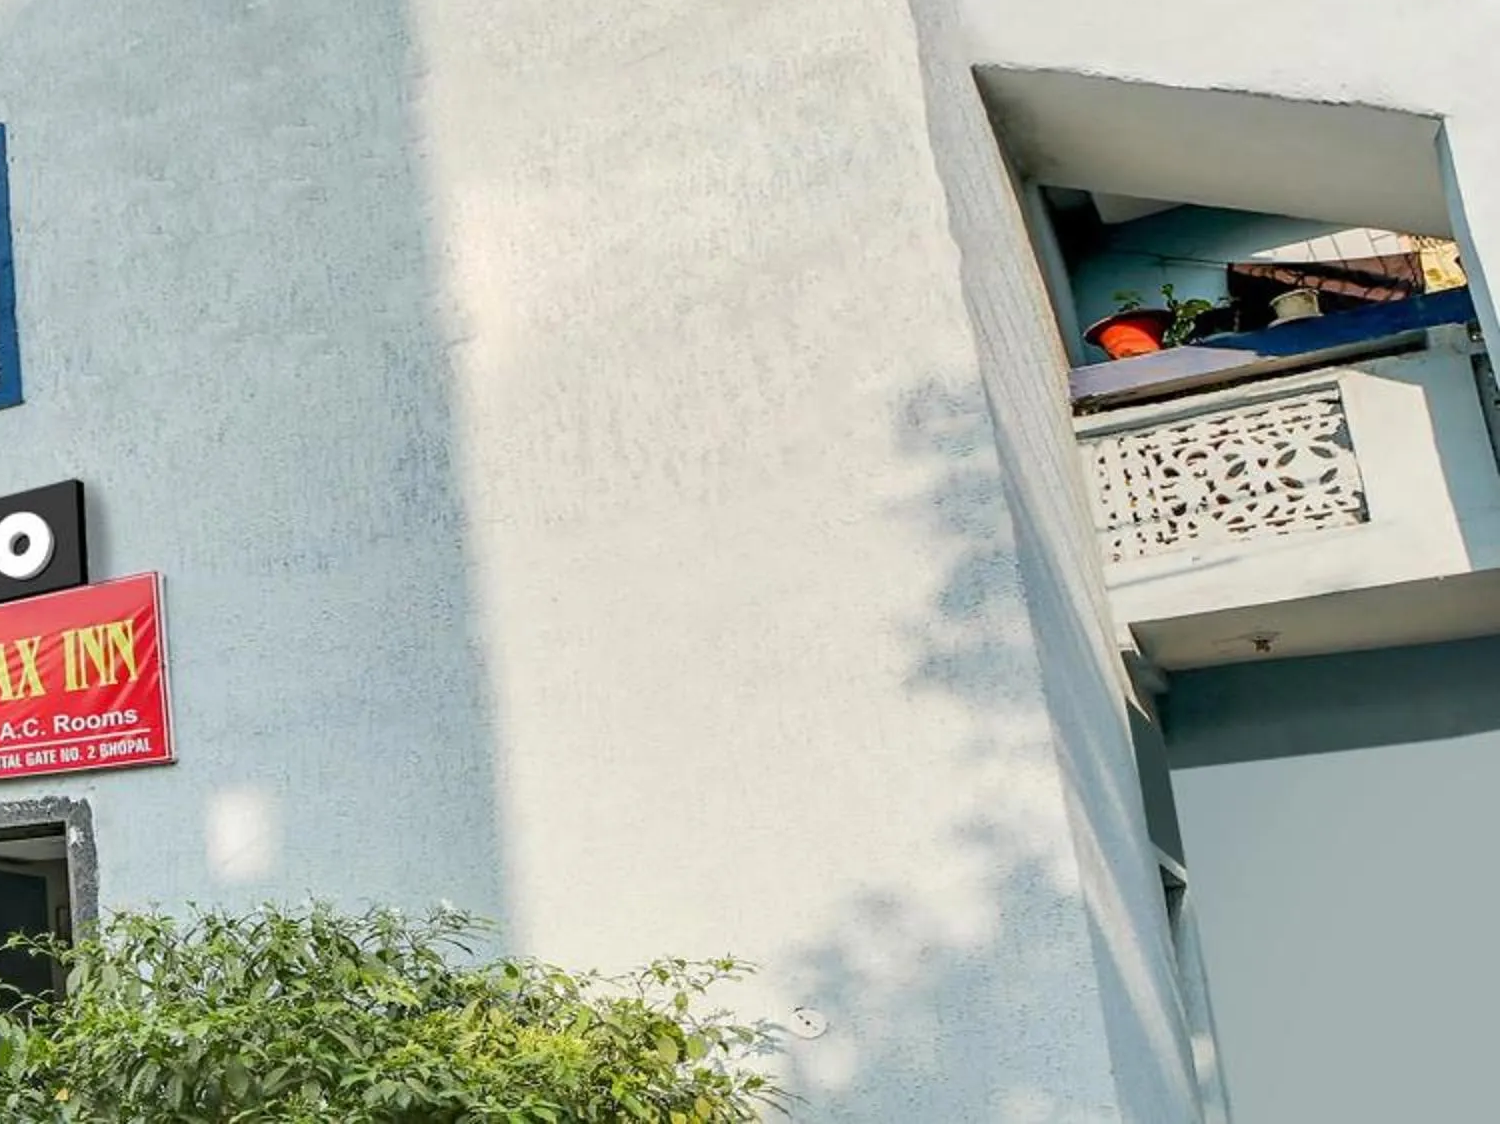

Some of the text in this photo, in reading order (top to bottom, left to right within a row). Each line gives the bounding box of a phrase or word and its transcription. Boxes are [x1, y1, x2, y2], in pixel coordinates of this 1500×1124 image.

[63, 619, 139, 693] INN
[0, 717, 47, 741] A.C.
[53, 708, 139, 735] Rooms
[25, 749, 57, 767] GATE
[86, 744, 97, 759] 2
[99, 737, 152, 759] BHOPAL
